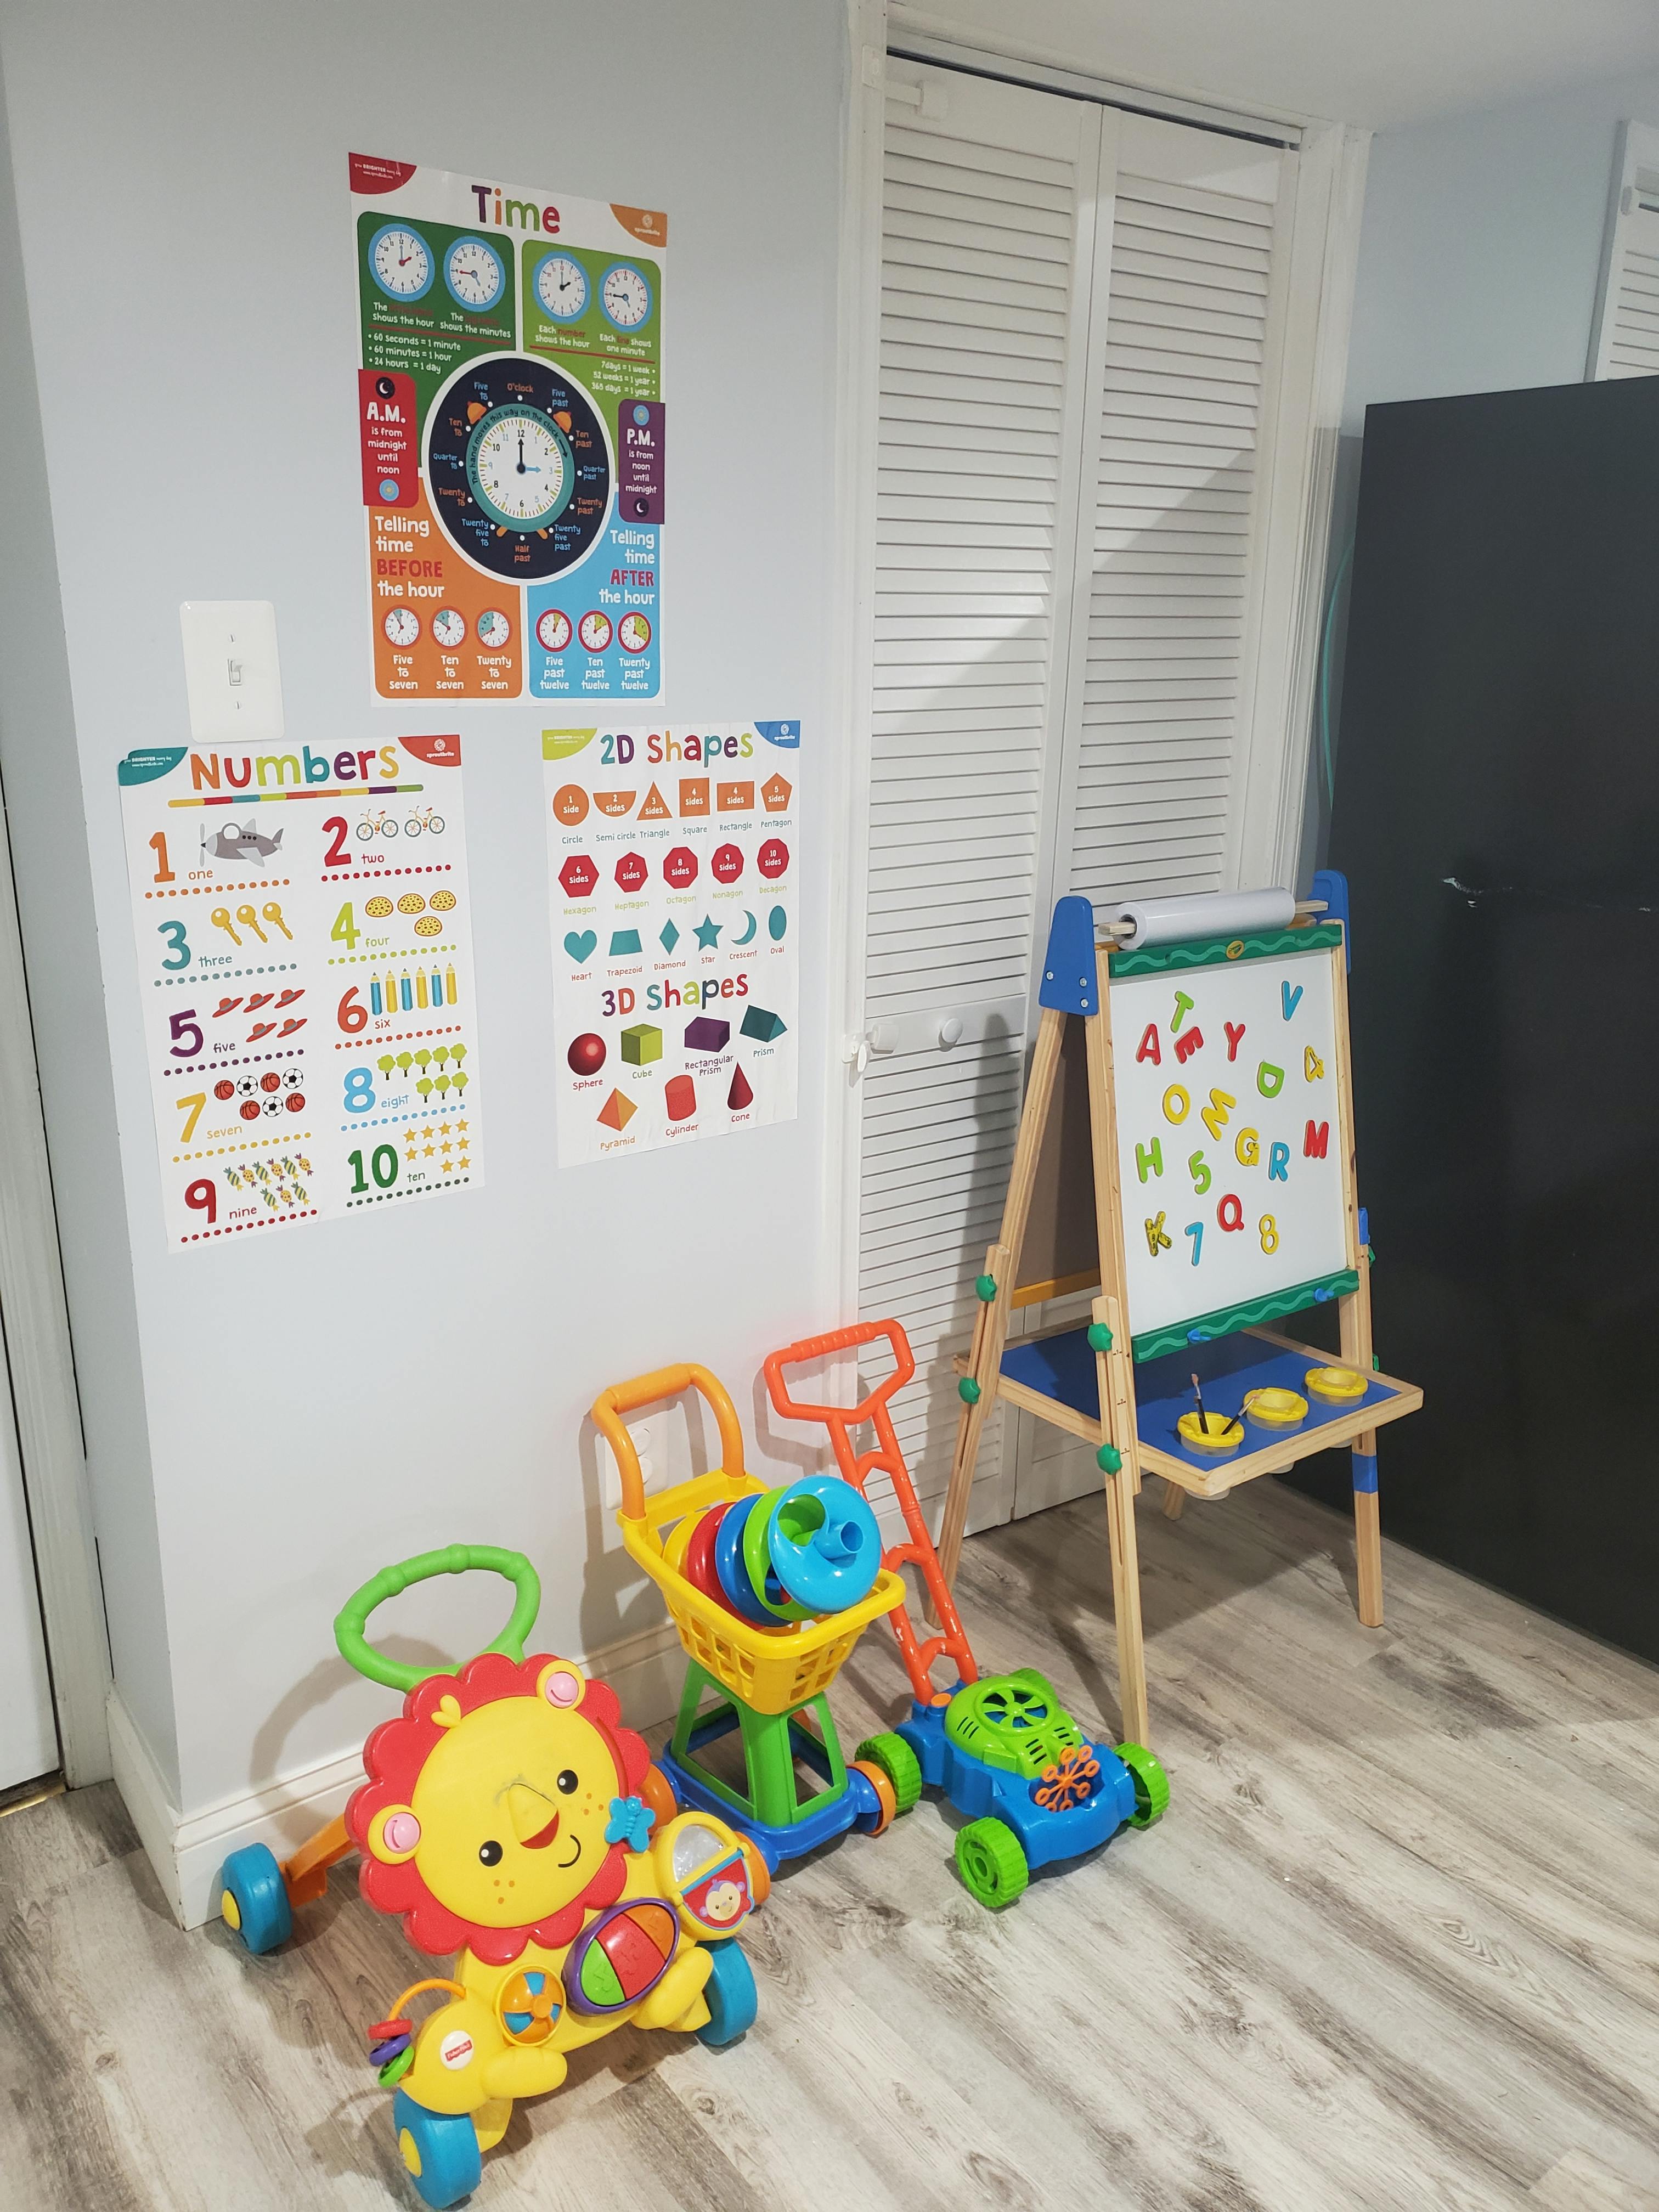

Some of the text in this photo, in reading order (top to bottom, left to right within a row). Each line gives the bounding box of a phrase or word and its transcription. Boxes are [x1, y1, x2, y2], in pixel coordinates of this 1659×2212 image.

[471, 184, 560, 234] Time
[373, 302, 387, 312] The
[373, 313, 435, 328] shows the hour
[451, 313, 463, 321] The
[440, 321, 511, 338] shows the minutes
[539, 325, 556, 335] Each
[374, 333, 383, 342] 60
[385, 335, 419, 346] seconds
[428, 339, 432, 348] 1
[433, 340, 461, 351] minute
[535, 335, 590, 348] shows the hour
[374, 345, 383, 354] 60
[386, 348, 420, 358] minutes
[429, 351, 432, 359] 1
[435, 352, 452, 362] hour
[374, 357, 383, 366] 24
[386, 359, 408, 369] hours
[426, 363, 441, 374] day
[507, 383, 533, 393] O'clock
[552, 389, 565, 397] Five
[552, 398, 568, 407] past
[366, 402, 406, 424] A.M.
[490, 411, 503, 421] this
[504, 408, 518, 417] way
[543, 420, 560, 439] clock
[371, 427, 403, 437] is from
[627, 428, 655, 447] P.M.
[368, 440, 407, 451] midnight
[377, 453, 398, 462] until
[636, 451, 654, 460] from
[633, 473, 650, 482] until
[625, 486, 657, 495] midnight
[375, 516, 429, 537] Telling
[375, 535, 413, 552] time
[610, 530, 654, 549] Telling
[624, 549, 654, 564] time
[377, 558, 443, 577] BEFORE
[610, 568, 654, 586] AFTER
[377, 580, 444, 598] the hour
[599, 589, 655, 605] the hour
[393, 655, 413, 664] Five
[441, 655, 459, 665] Ten
[477, 656, 511, 668] Twenty
[546, 657, 563, 666] Five
[588, 657, 602, 666] Ten
[619, 657, 650, 669] Twenty
[397, 667, 409, 677] to
[444, 667, 455, 677] to
[488, 667, 499, 677] to
[544, 668, 565, 679] past
[585, 669, 605, 680] past
[624, 669, 644, 680] past
[540, 680, 569, 690] twelve
[582, 680, 609, 690] twelve
[621, 680, 648, 690] twelve
[600, 731, 753, 768] 2D Shapes
[190, 746, 399, 790] Numbers
[682, 826, 707, 836] Square
[720, 822, 752, 832] Rectangle
[760, 820, 792, 829] Pentagon
[596, 832, 636, 842] Semi circle
[640, 828, 669, 838] Triangle
[322, 816, 384, 867] 2 two
[149, 832, 213, 883] 1 one
[713, 890, 743, 899] Nonagon
[759, 885, 787, 894] Decagon
[615, 901, 650, 911] Heptagon
[666, 895, 696, 904] Octagon
[563, 906, 597, 915] Hexagon
[330, 902, 390, 950] 4 four
[157, 921, 233, 970] 3 three
[770, 946, 785, 955] Oval
[701, 956, 715, 964] Star
[730, 950, 757, 960] Crescent
[607, 966, 642, 977] Trapezoid
[654, 960, 686, 970] Diamond
[572, 972, 592, 981] Heart
[602, 974, 748, 1017] 3D Shapes
[1282, 981, 1304, 1021] V
[337, 986, 391, 1034] 6 six
[1170, 991, 1194, 1032] T
[169, 1009, 236, 1058] 5 five
[1136, 1024, 1161, 1065] A
[1223, 1022, 1245, 1062] Y
[685, 1056, 733, 1070] Rectangular
[633, 1070, 652, 1079] Cube
[343, 1067, 409, 1113] 8 eight
[573, 1079, 603, 1091] Sphere
[176, 1092, 242, 1143] 7 seven
[732, 1113, 750, 1122] Cone
[666, 1124, 699, 1138] Cylinder
[600, 1136, 635, 1151] Pyramid
[1304, 1120, 1329, 1159] M
[1235, 1127, 1260, 1166] G
[1135, 1137, 1164, 1184] H
[1268, 1142, 1290, 1182] R
[348, 1144, 425, 1194] 10 ten
[1188, 1150, 1211, 1194] 5
[184, 1178, 257, 1223] 9 nine
[1217, 1194, 1244, 1232] Q
[1145, 1211, 1172, 1256] K
[1259, 1214, 1279, 1255] 8
[1185, 1221, 1204, 1266] 7
